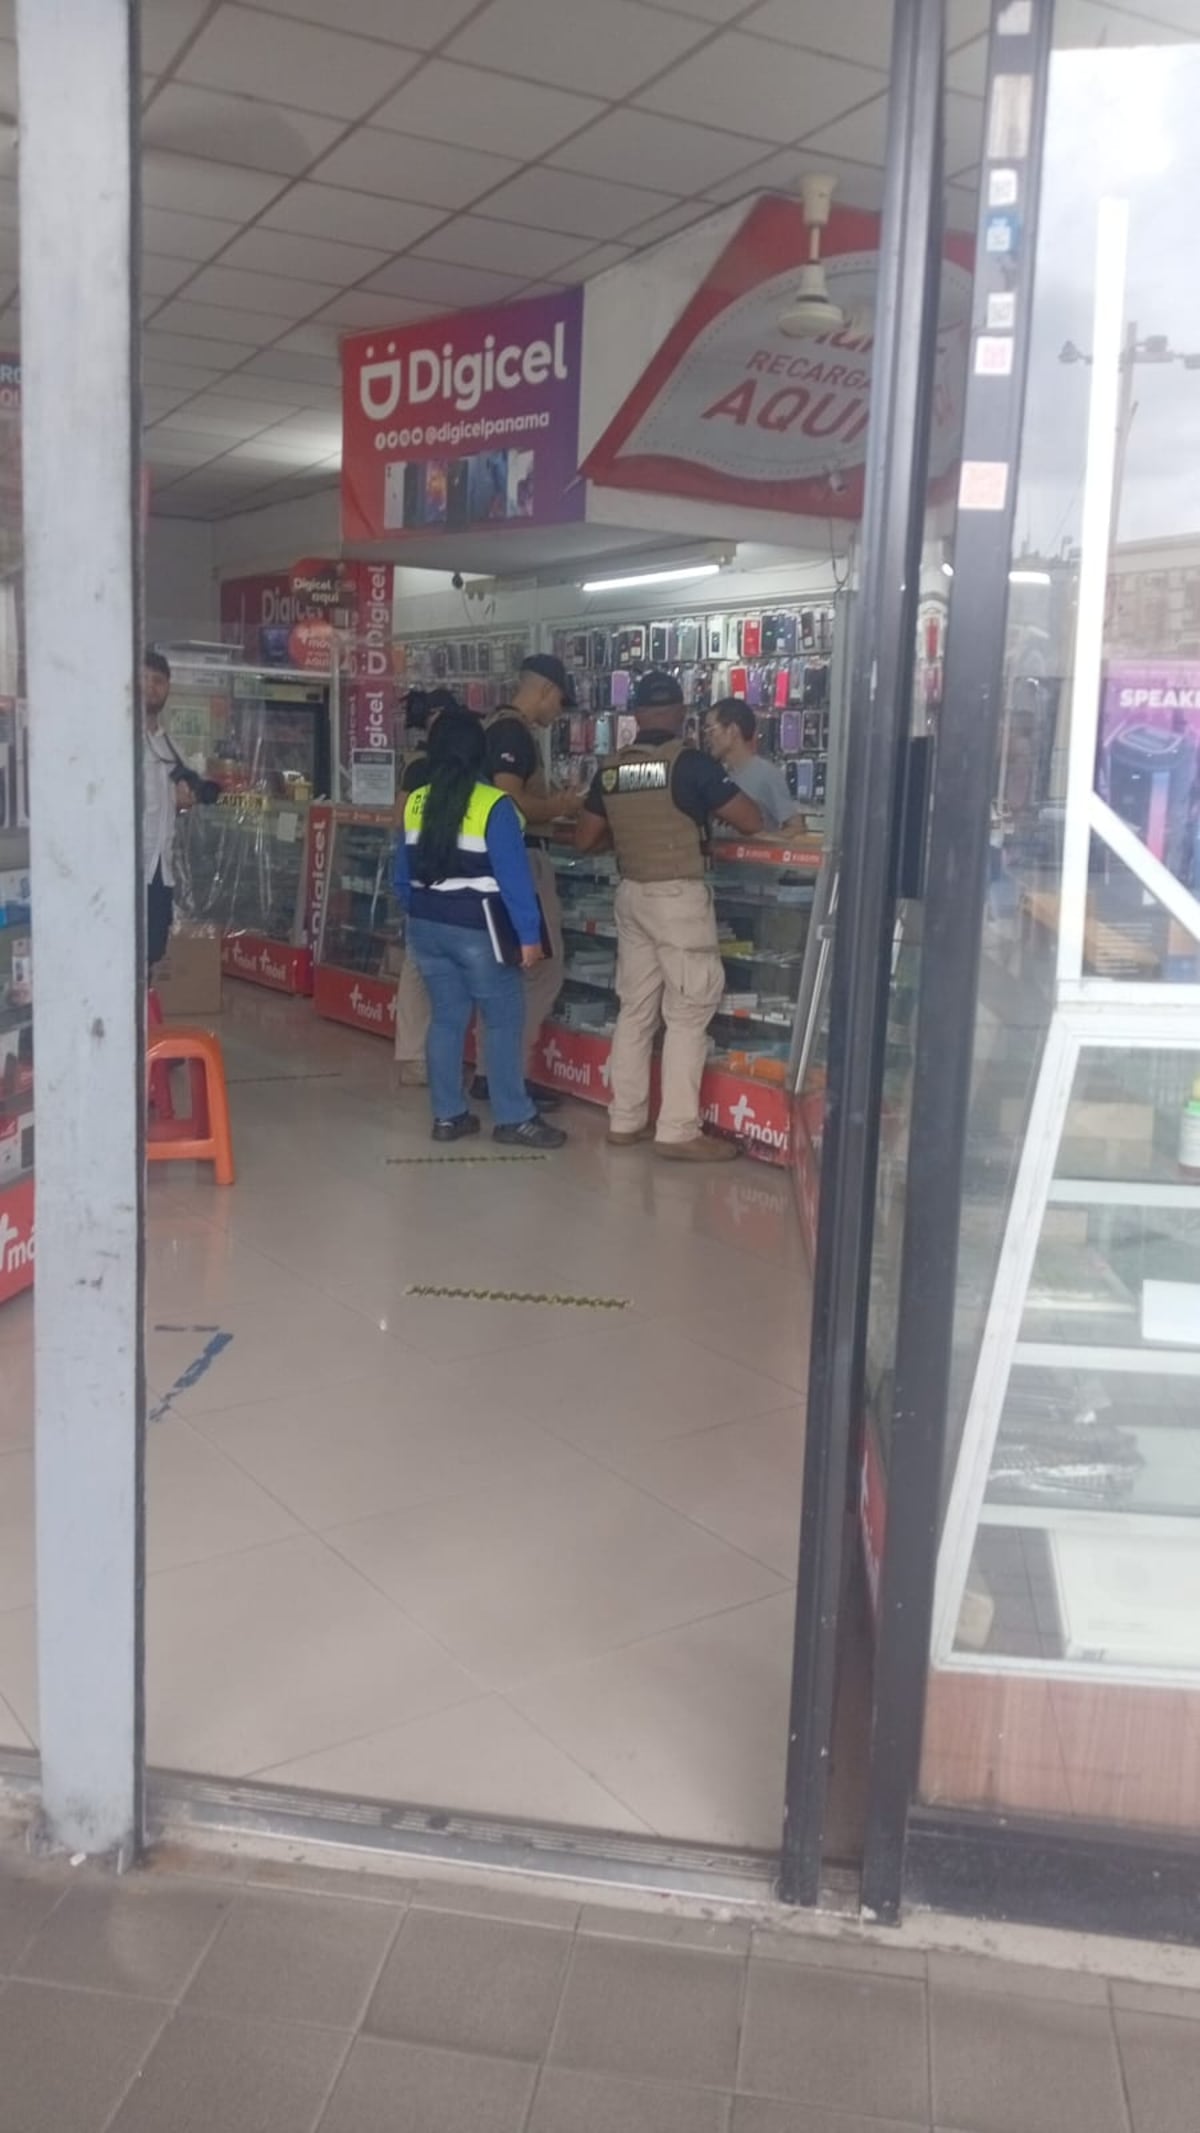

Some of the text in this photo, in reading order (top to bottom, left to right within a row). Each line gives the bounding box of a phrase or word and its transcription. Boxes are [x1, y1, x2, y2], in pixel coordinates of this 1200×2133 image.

[408, 321, 568, 412] Digicel
[425, 412, 550, 446] @digicelpanama
[366, 565, 390, 648] Digicel
